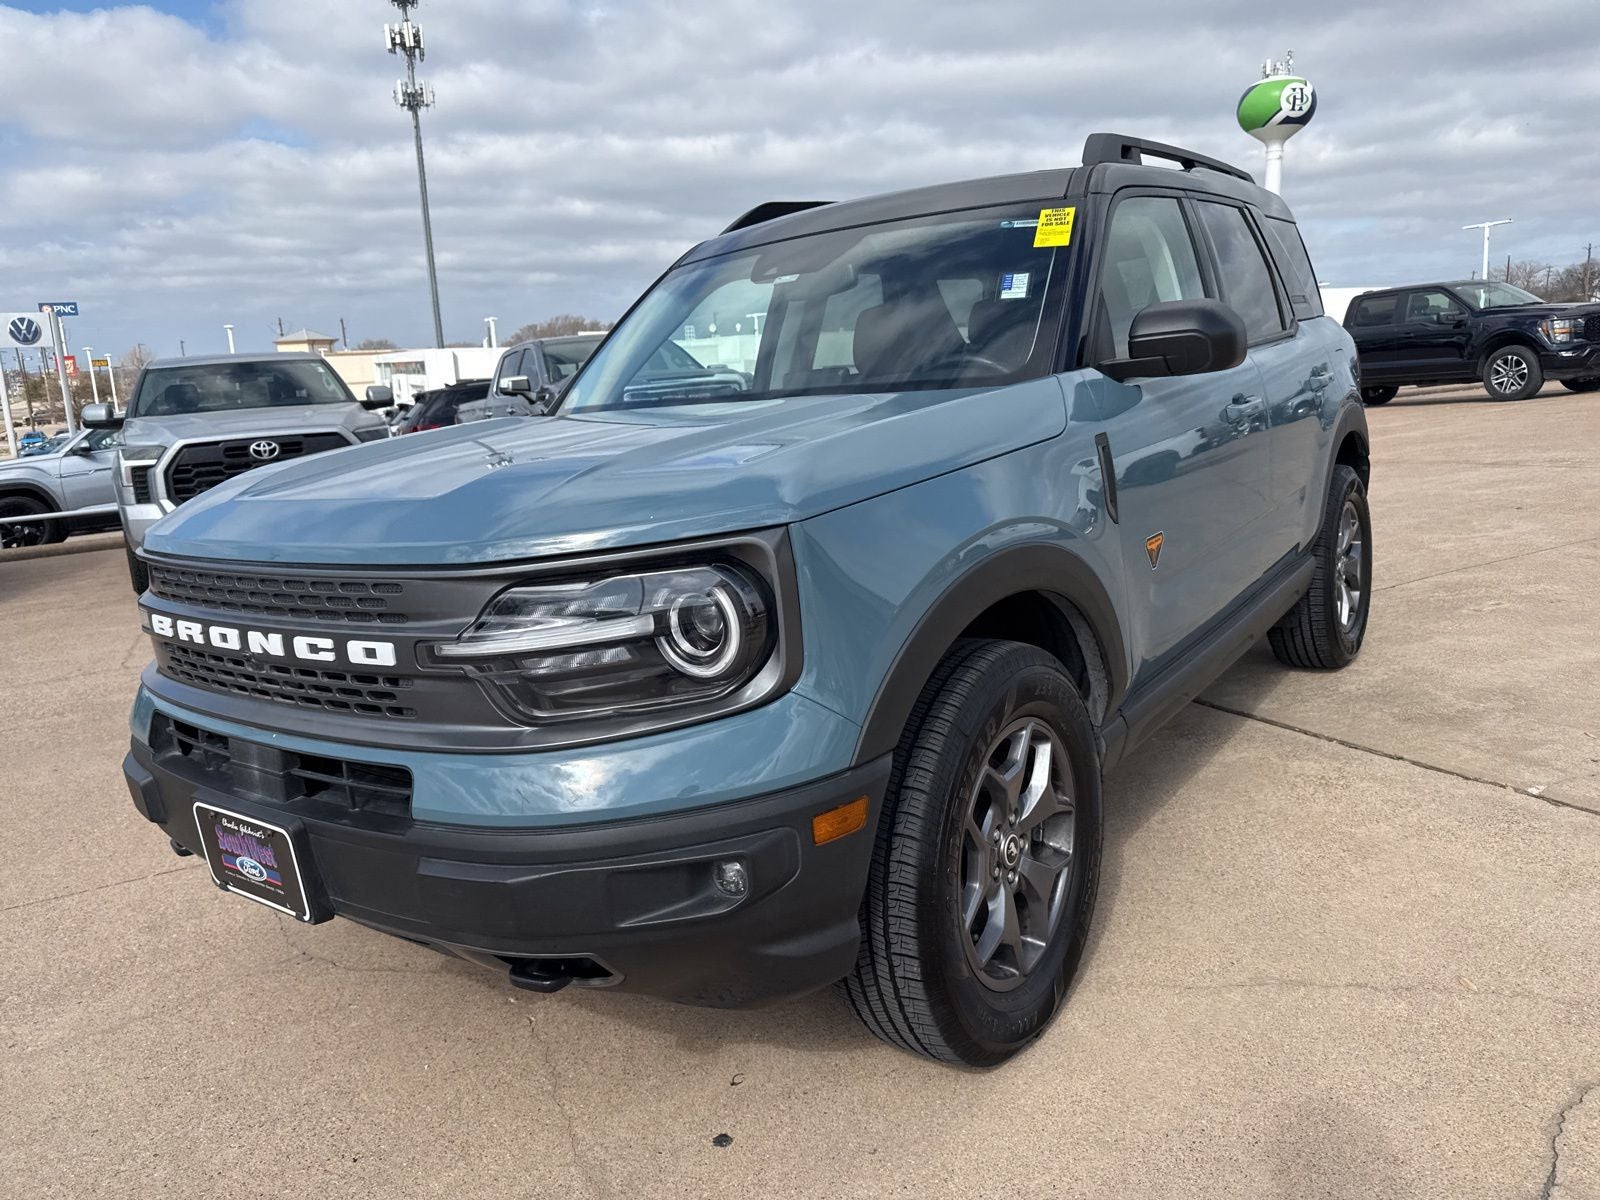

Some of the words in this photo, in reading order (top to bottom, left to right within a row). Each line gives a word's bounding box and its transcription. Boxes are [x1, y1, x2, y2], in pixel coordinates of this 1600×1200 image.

[53, 305, 76, 314] PNC
[151, 614, 397, 667] BRONCO
[243, 860, 261, 877] Ford
